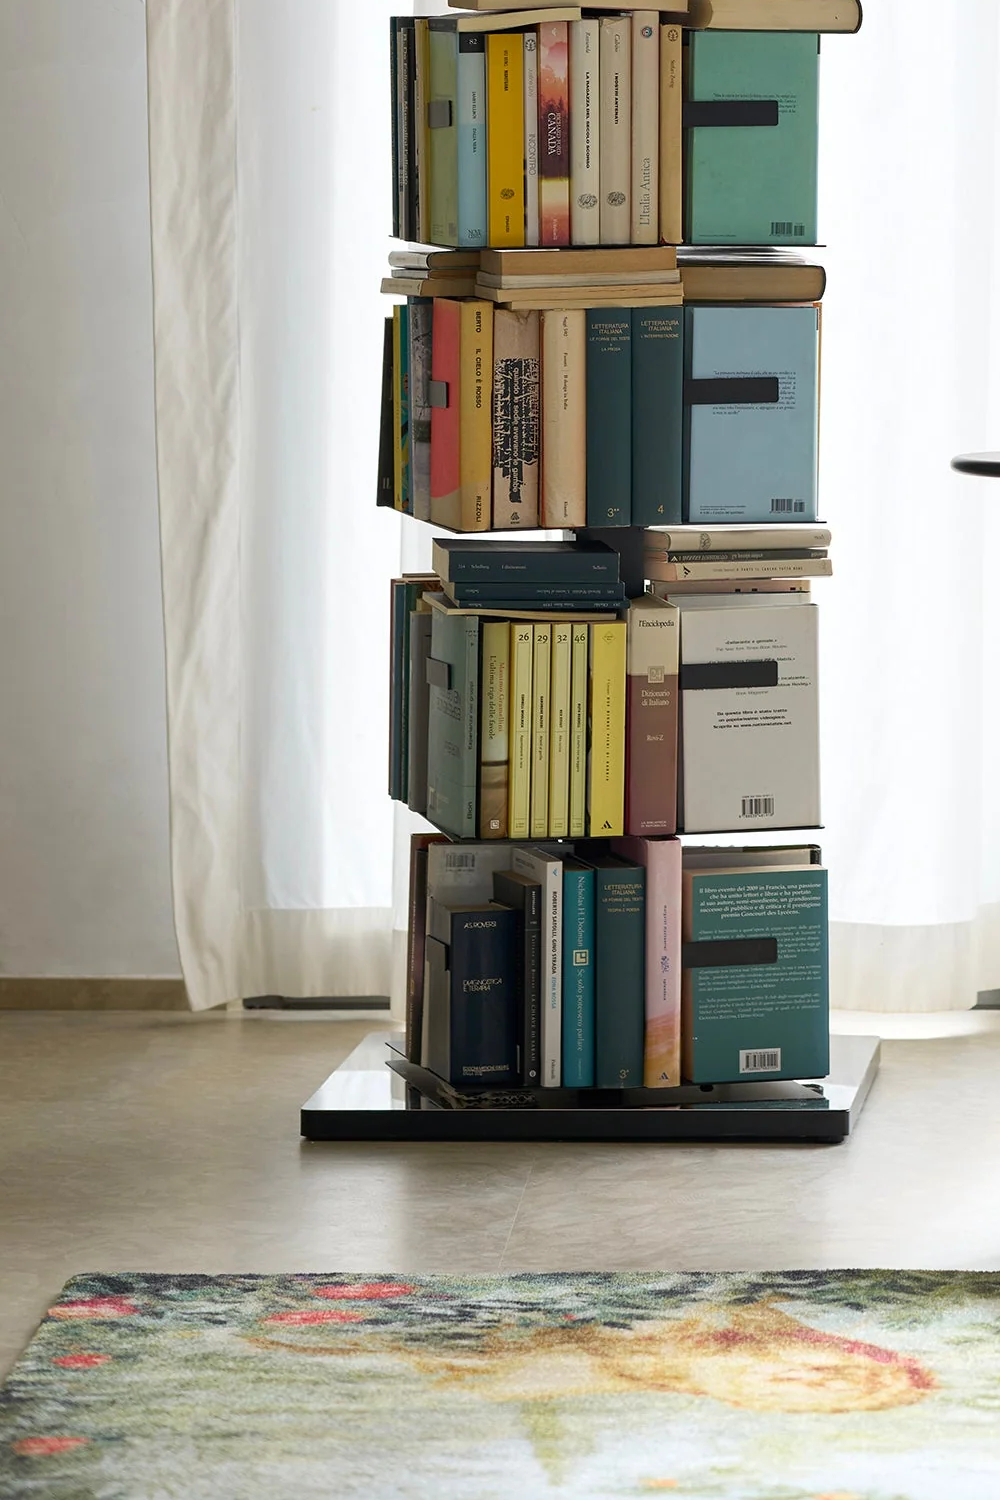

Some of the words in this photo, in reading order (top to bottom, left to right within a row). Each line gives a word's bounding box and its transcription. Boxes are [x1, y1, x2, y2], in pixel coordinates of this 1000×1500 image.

[548, 112, 557, 155] CANADA
[529, 133, 537, 175] INCONTRO
[639, 158, 650, 191] Antica
[639, 193, 650, 225] L'Italia
[512, 367, 520, 394] quando
[512, 467, 520, 492] gambe
[657, 504, 664, 514] 4
[638, 620, 675, 629] l'Enciclopedia
[518, 633, 530, 641] 26
[537, 635, 548, 643] 29
[557, 634, 567, 643] 32
[574, 633, 586, 642] 46
[488, 655, 497, 685] L'ultima
[650, 669, 662, 679] 24
[487, 686, 496, 700] riga
[641, 689, 670, 698] Dizionario
[488, 701, 496, 718] delle
[649, 698, 670, 706] Italiano
[488, 719, 496, 740] favole
[576, 876, 585, 907] Nicholas
[788, 895, 821, 903] grandissimo
[577, 917, 585, 947] Dodman
[577, 979, 585, 993] solo
[575, 995, 585, 1025] potessero
[575, 1026, 585, 1052] parlare
